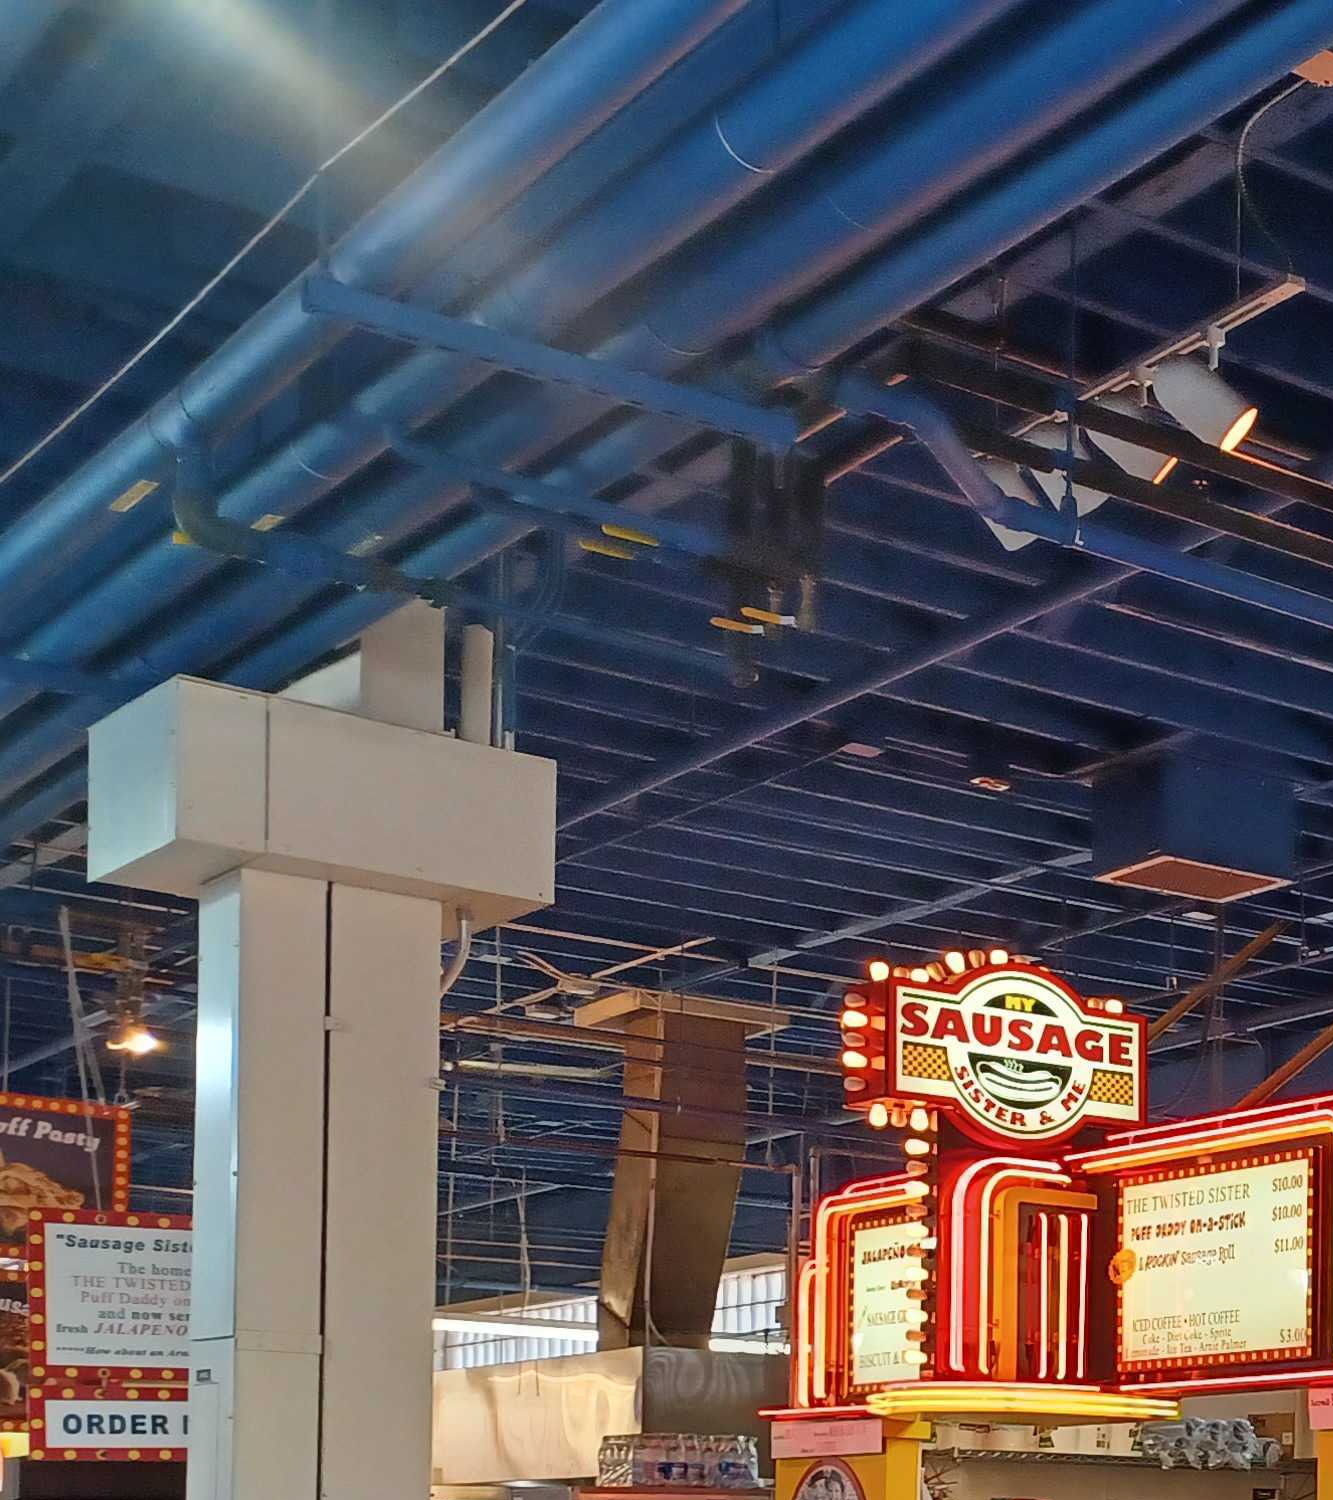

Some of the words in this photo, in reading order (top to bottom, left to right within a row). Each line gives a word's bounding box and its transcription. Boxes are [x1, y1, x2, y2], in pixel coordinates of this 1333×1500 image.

[1004, 996, 1036, 1011] MY
[900, 1002, 1134, 1067] SAUSAGE
[954, 1065, 1027, 1127] SISTER
[1039, 1110, 1056, 1126] &
[1061, 1079, 1087, 1112] ME
[33, 1120, 100, 1152] Pasty
[1127, 1198, 1149, 1215] THE
[1152, 1189, 1205, 1211] TWISTED
[1208, 1183, 1251, 1204] SISTER
[1272, 1174, 1303, 1193] $10.00
[1271, 1203, 1303, 1222] $10.00
[56, 1234, 145, 1254] "Sausage
[1274, 1235, 1304, 1254] $11.00
[72, 1275, 105, 1289] THE
[112, 1276, 192, 1291] TWISTED
[80, 1290, 113, 1304] Puff
[119, 1292, 166, 1309] Daddy
[62, 1413, 169, 1436] ORDER
